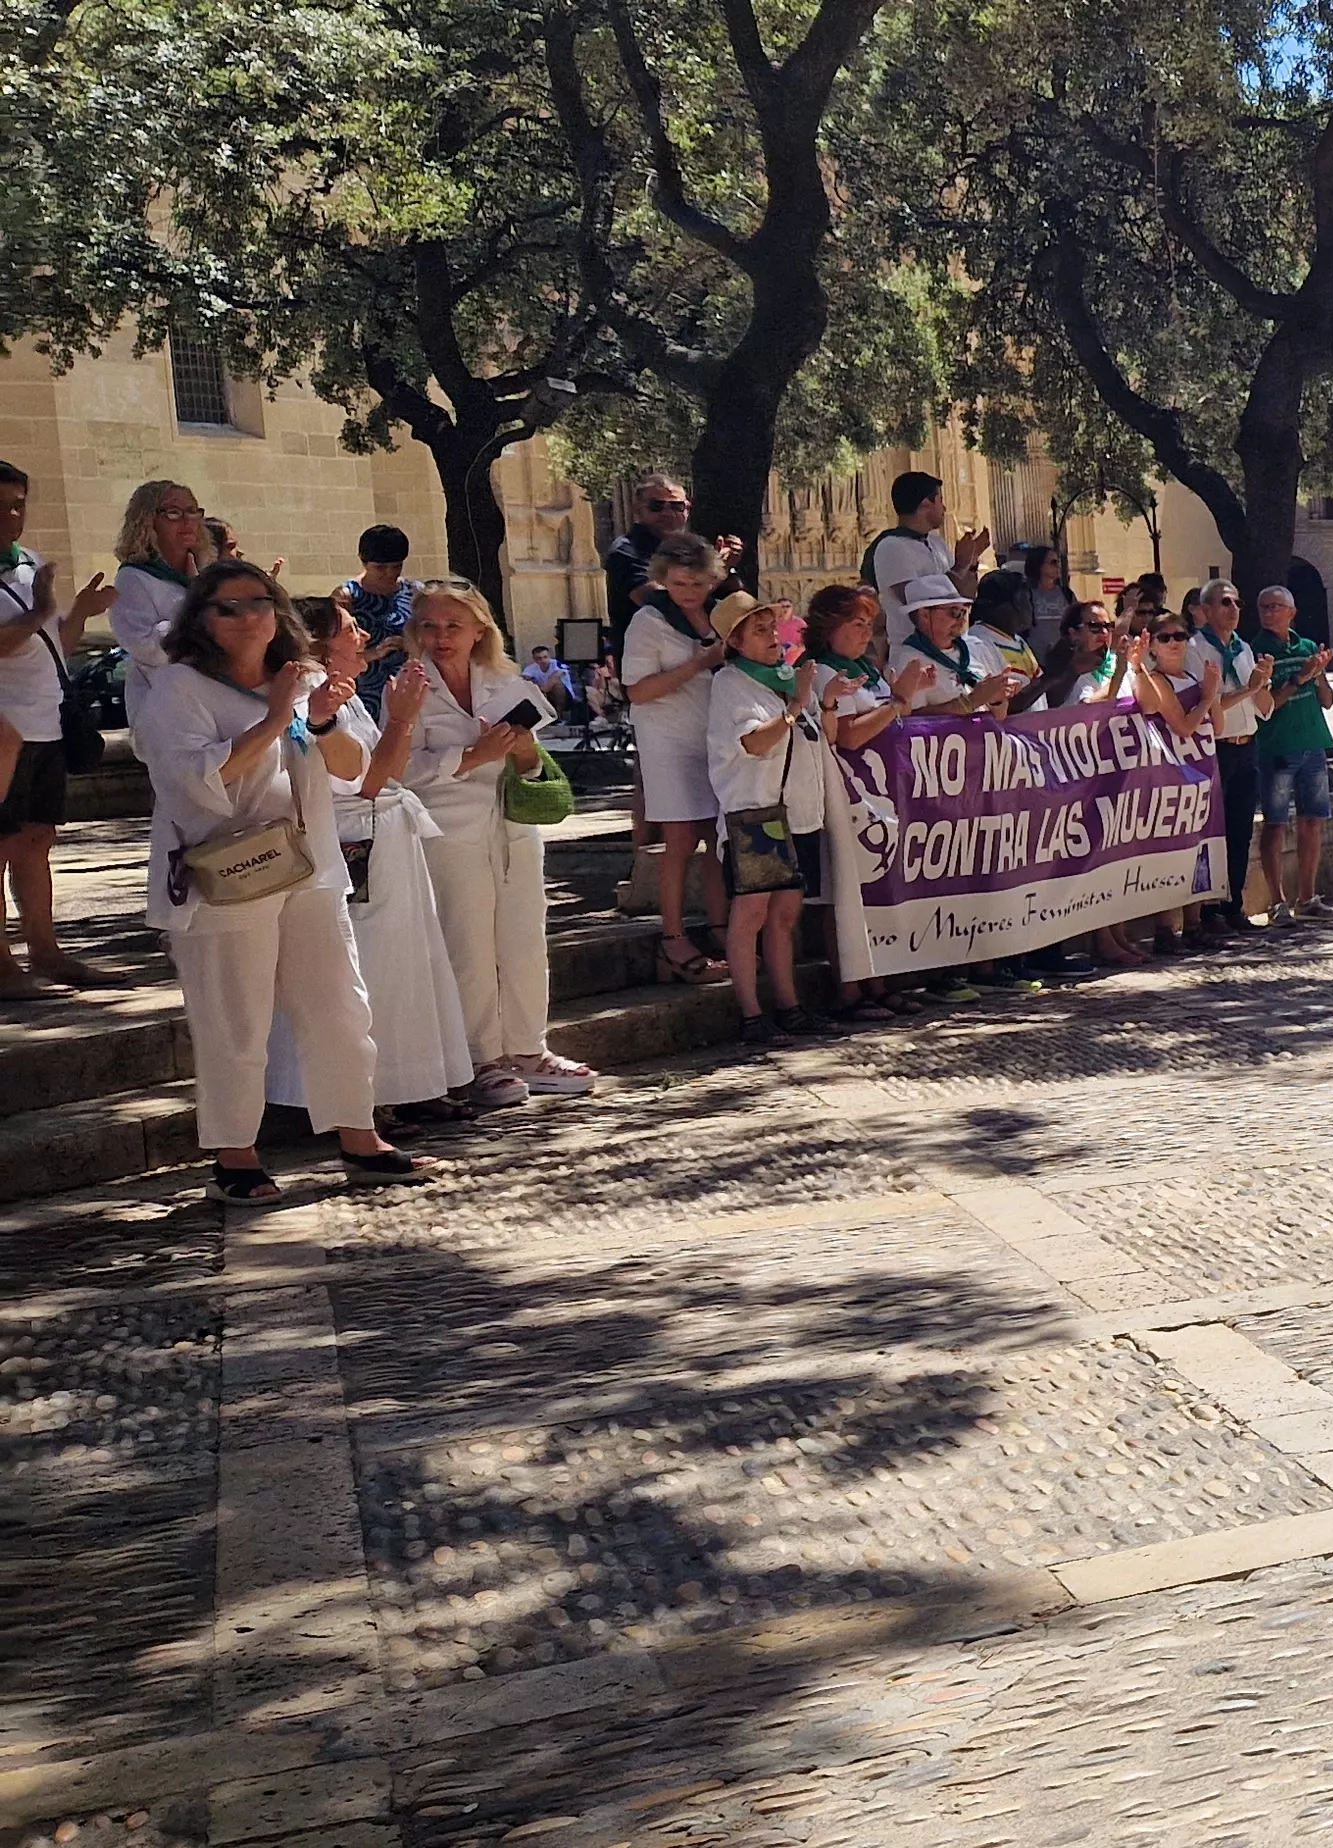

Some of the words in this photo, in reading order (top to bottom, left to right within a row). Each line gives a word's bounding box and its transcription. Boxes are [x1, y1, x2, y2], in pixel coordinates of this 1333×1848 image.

[910, 733, 967, 799] NO
[982, 731, 1046, 793] MAS
[218, 848, 282, 878] CACHAREL
[903, 810, 1031, 883] CONTRA
[1034, 800, 1091, 865] LAS
[909, 905, 1014, 959] Mujeres
[1021, 888, 1114, 927] Feministas
[1123, 864, 1186, 896] Huesca
